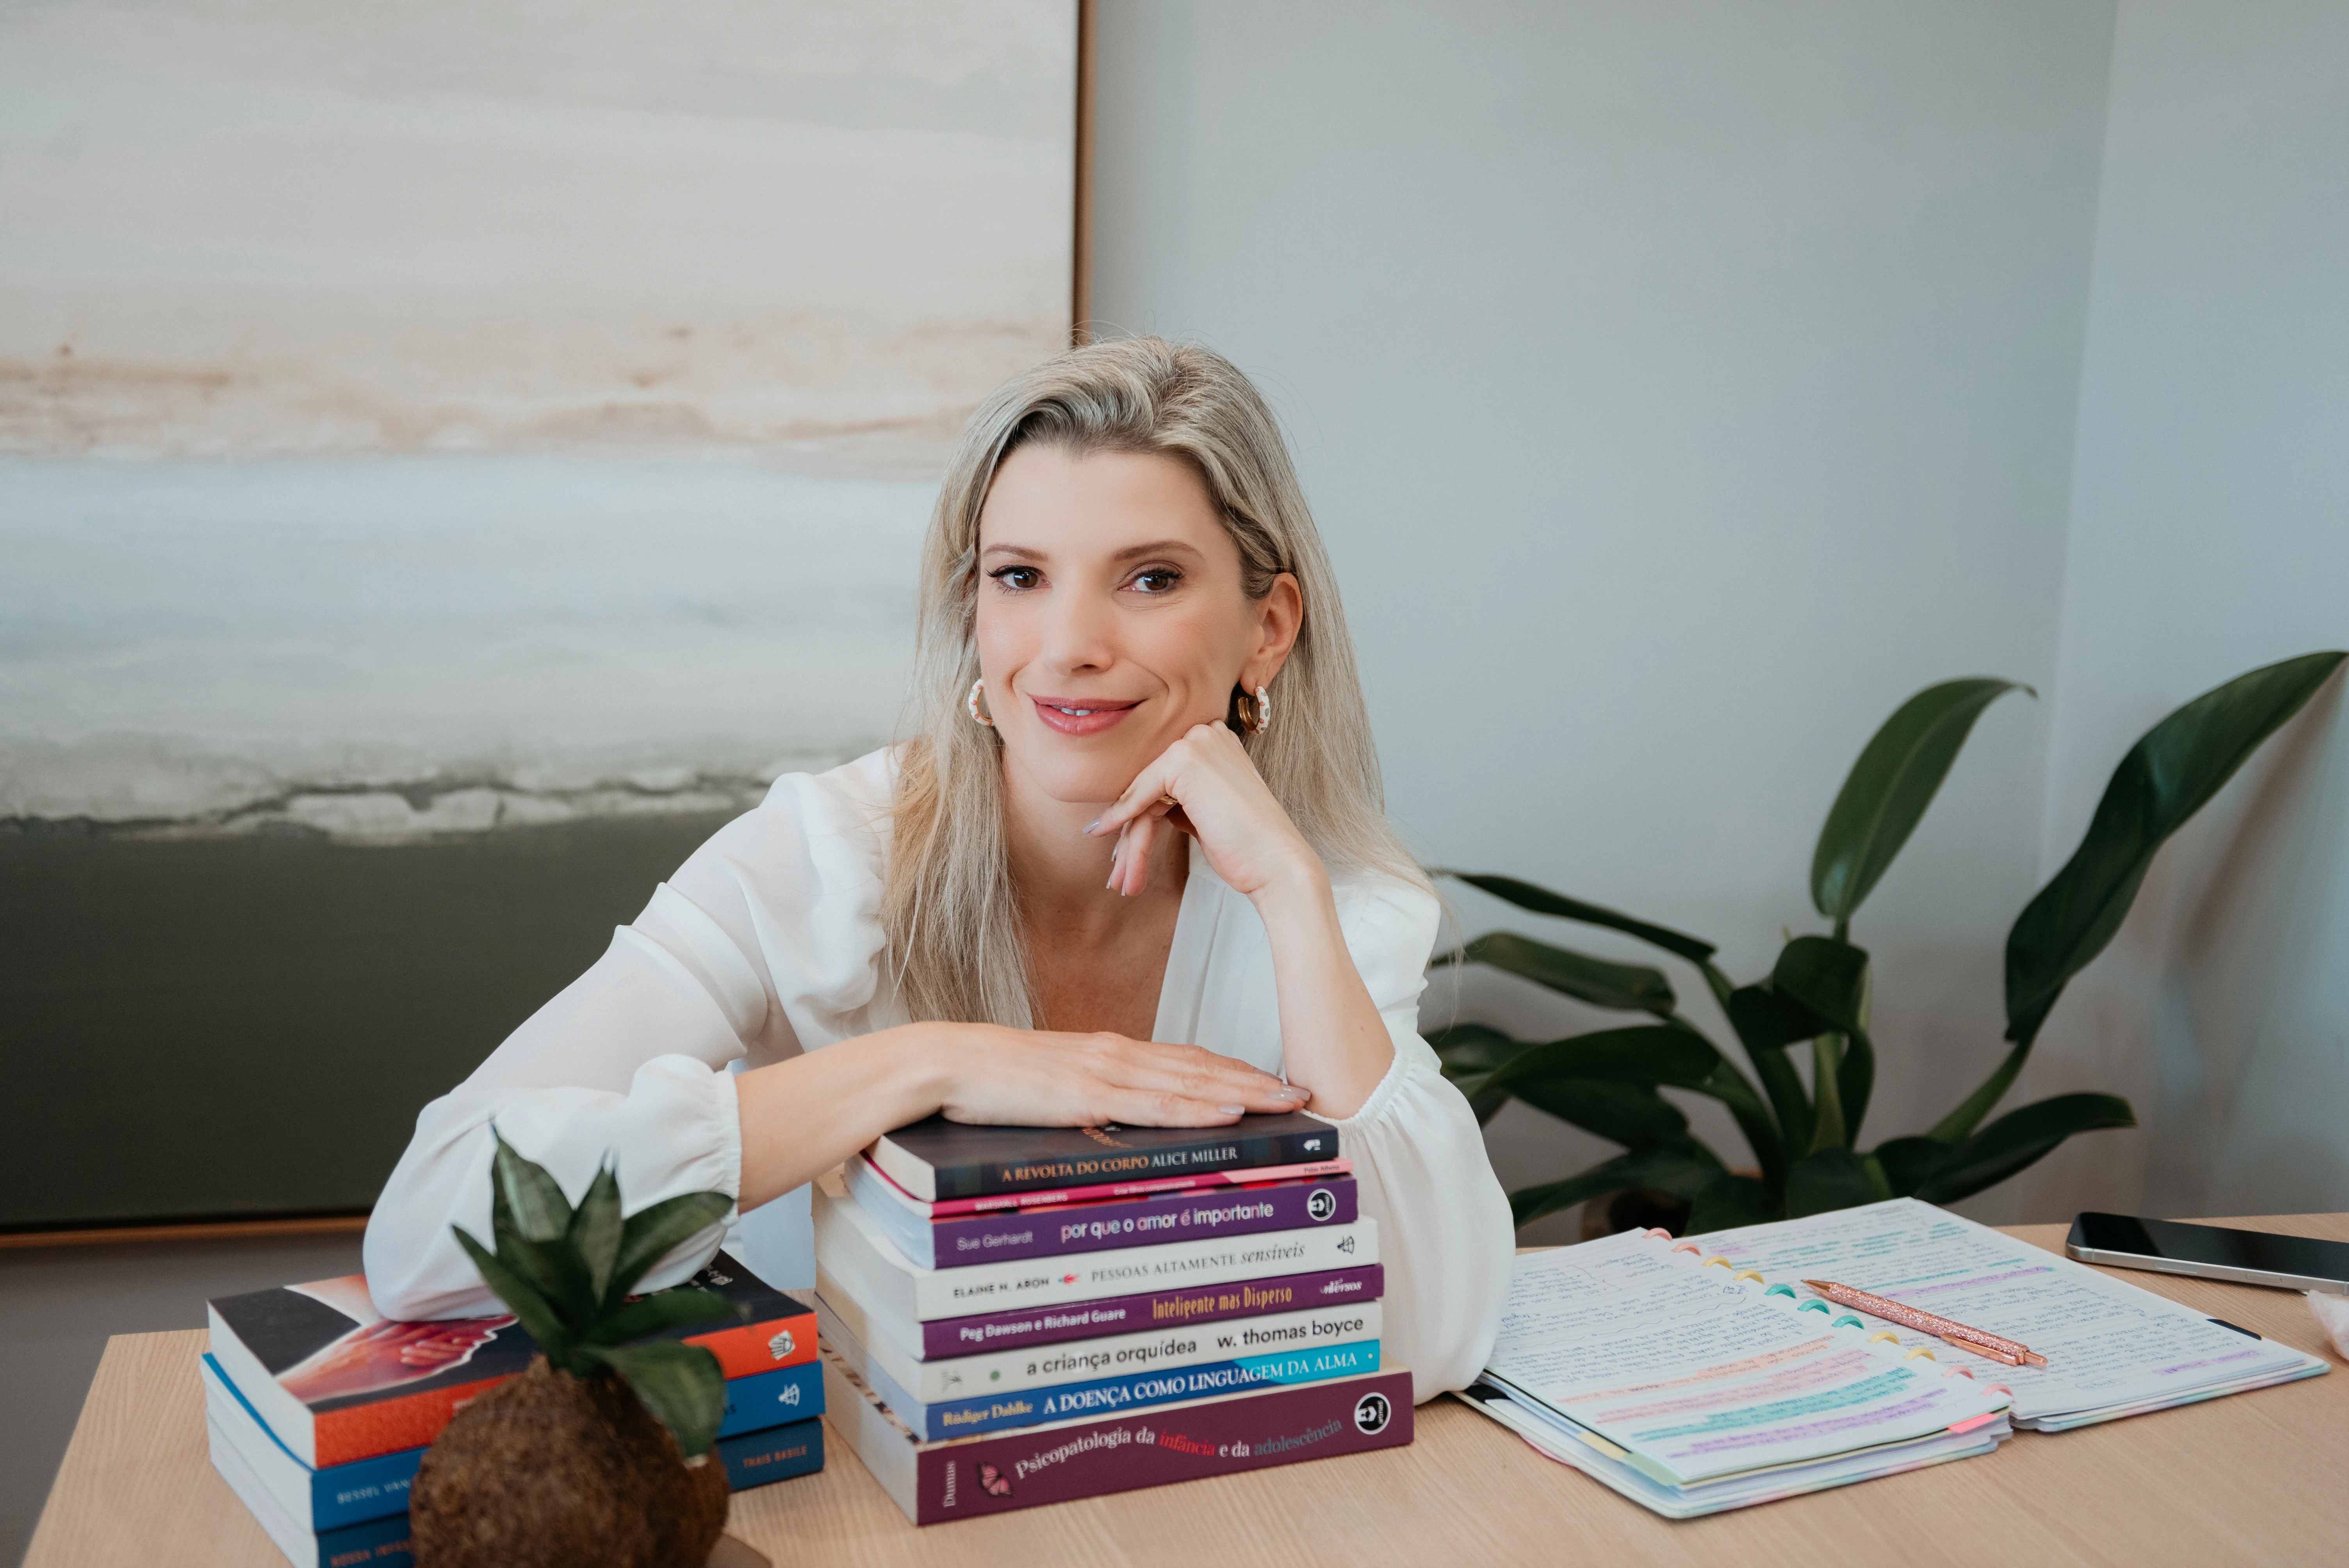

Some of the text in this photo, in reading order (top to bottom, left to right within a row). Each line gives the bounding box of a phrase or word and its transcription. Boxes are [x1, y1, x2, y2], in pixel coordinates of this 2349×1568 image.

[1002, 1147, 1238, 1182] A REVOLTA DO CORPO ALICE MILLER
[1061, 1201, 1274, 1244] por que o amor é importante
[956, 1231, 1033, 1250] Sue Gerhardt
[1092, 1243, 1305, 1283] PESSOAS ALTAMENTE sensíveis
[954, 1285, 994, 1298] ELAINE
[1017, 1278, 1050, 1290] ARON
[1153, 1286, 1293, 1320] Inteligente mas Disperso
[960, 1308, 1126, 1342] Peg Dawson e Richard Guare
[1217, 1318, 1364, 1348] w. thomas boyce
[1027, 1338, 1197, 1376] a criança orquídea
[1043, 1352, 1357, 1415] A DOENÇA COMO LINGUAGEM DA ALMA
[991, 1400, 1034, 1419] Dahlke
[1015, 1418, 1343, 1480] Psicopatologia da infância e da adolescência
[943, 1460, 957, 1508] Dumas
